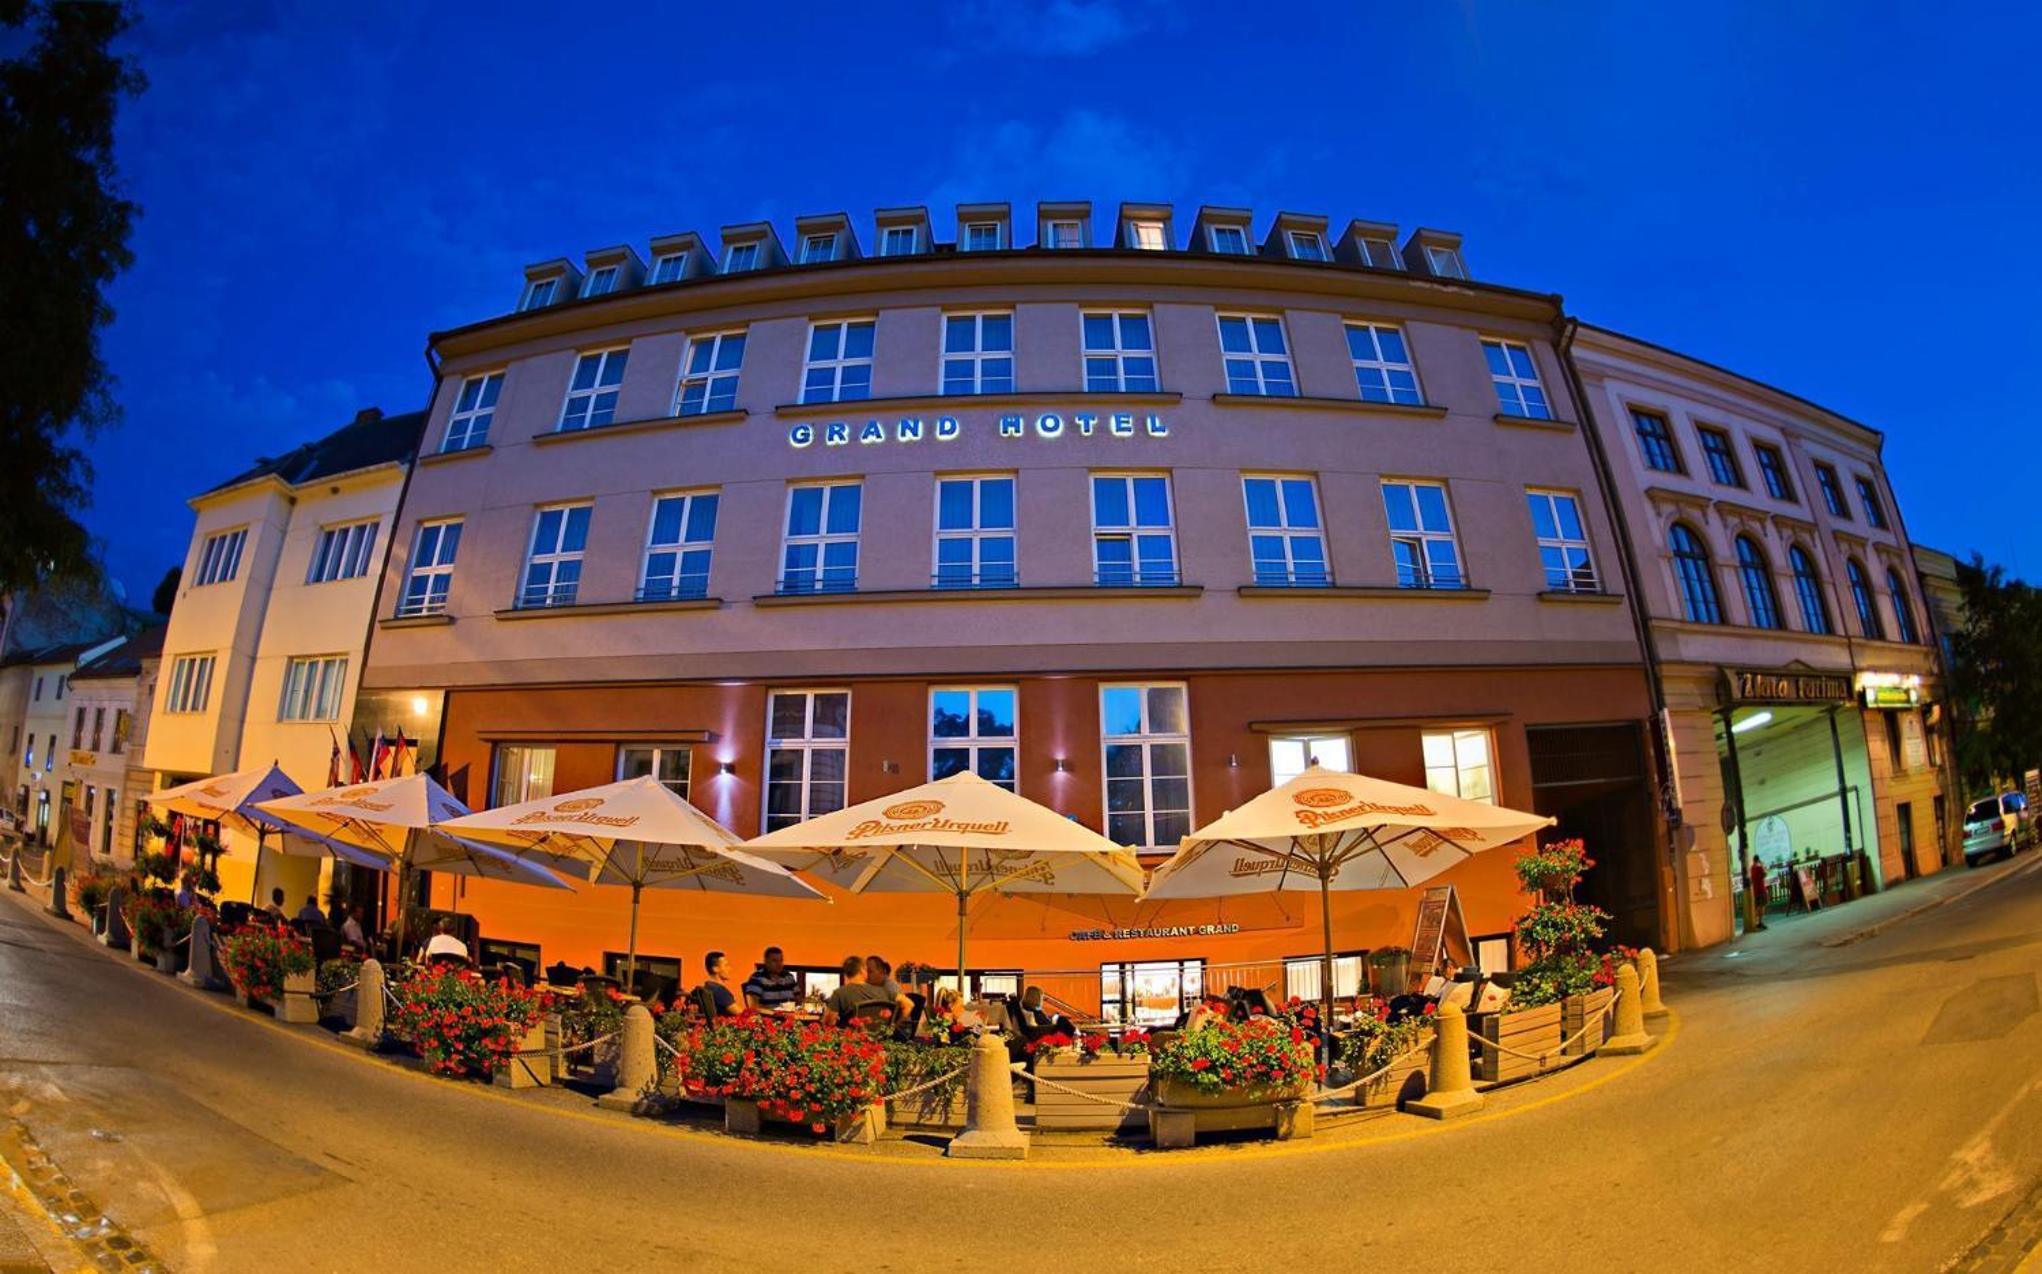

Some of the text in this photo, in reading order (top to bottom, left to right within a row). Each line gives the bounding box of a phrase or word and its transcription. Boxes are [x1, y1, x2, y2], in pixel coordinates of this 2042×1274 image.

[789, 412, 1171, 446] GRAND HOTEL
[846, 817, 1009, 841] Pilsner Urquell
[1114, 926, 1196, 940] RESTAURANT
[1199, 923, 1240, 935] GRAND
